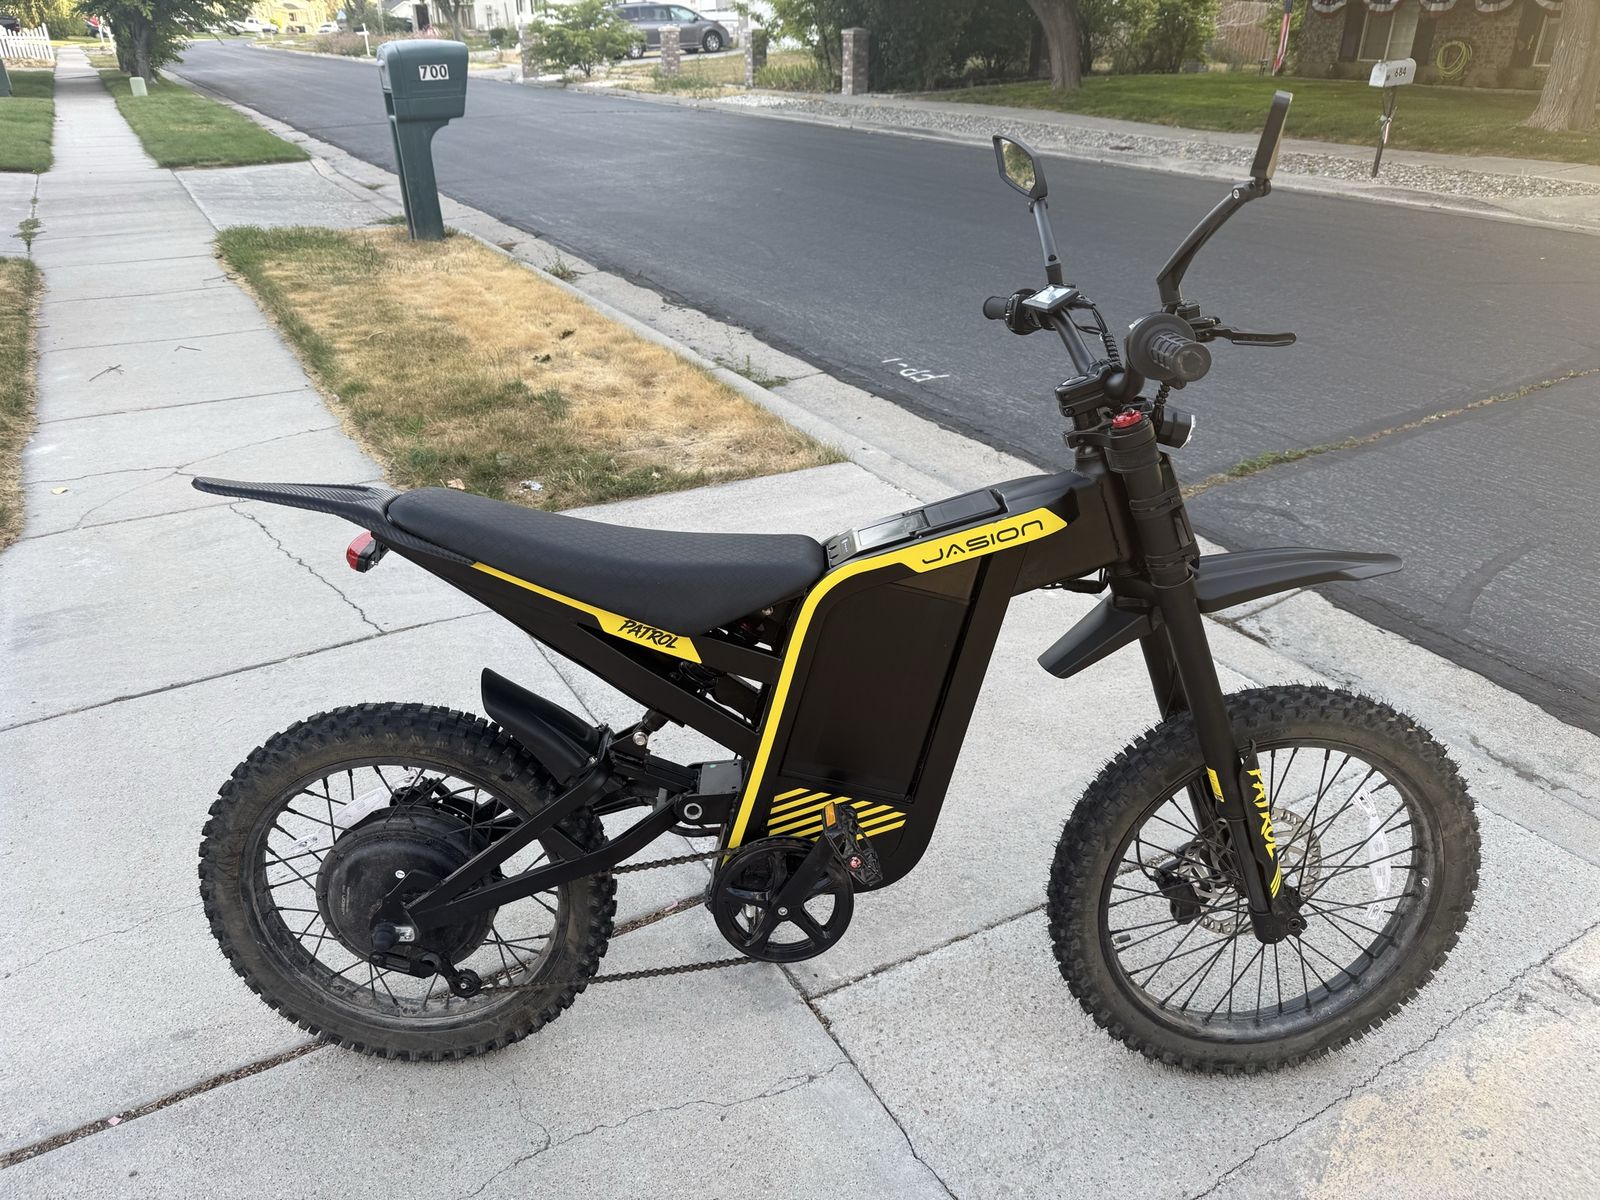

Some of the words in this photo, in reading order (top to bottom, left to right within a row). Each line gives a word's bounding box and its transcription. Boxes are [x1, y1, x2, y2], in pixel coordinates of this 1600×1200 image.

[420, 65, 447, 80] 700
[922, 520, 1044, 564] JASION
[617, 619, 679, 649] PATROL
